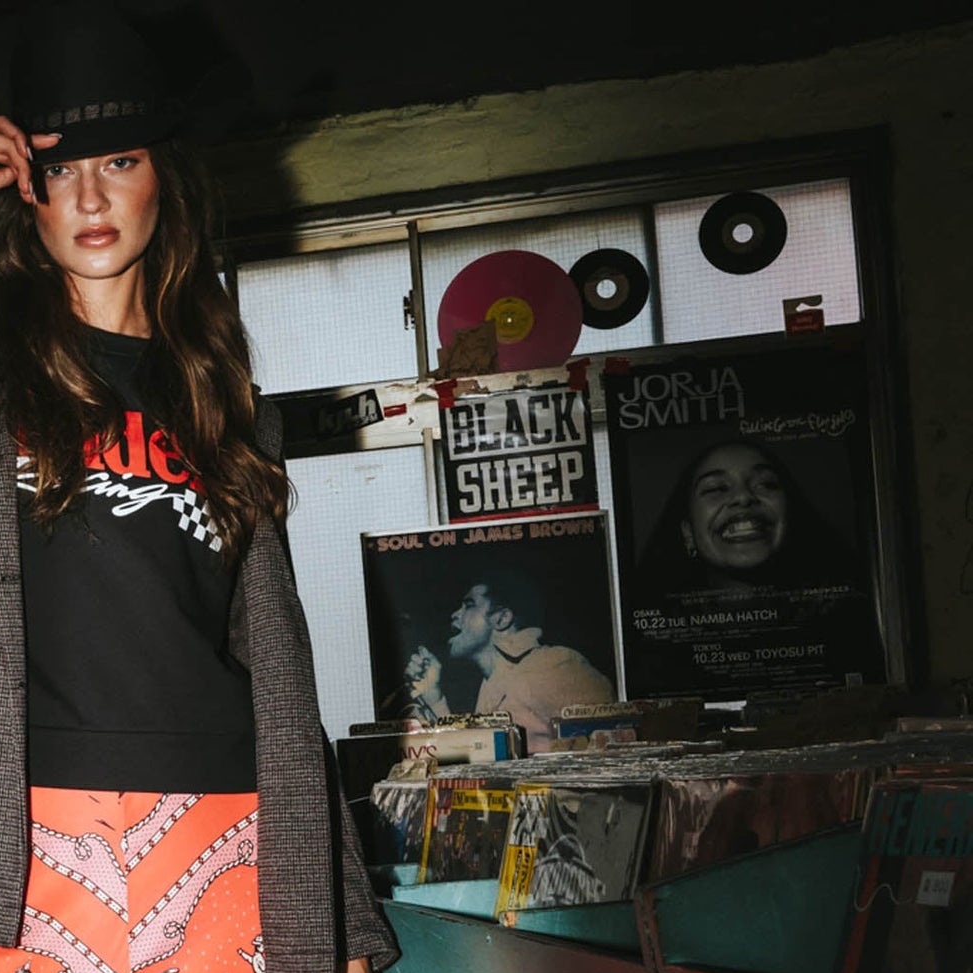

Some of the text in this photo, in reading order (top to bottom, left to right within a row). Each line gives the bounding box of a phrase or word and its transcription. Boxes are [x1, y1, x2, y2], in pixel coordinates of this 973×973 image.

[618, 366, 743, 403] JORJA
[450, 392, 580, 455] BLACK
[619, 390, 746, 429] SMITH
[456, 451, 584, 514] SHEEP
[377, 519, 595, 552] SOUL ON JAMES BROWN
[633, 608, 661, 618] OSAKA
[633, 608, 778, 630] 10.22 TUE NAMBA HATCH
[693, 644, 825, 664] 10.23 WED TOYOSU PIT
